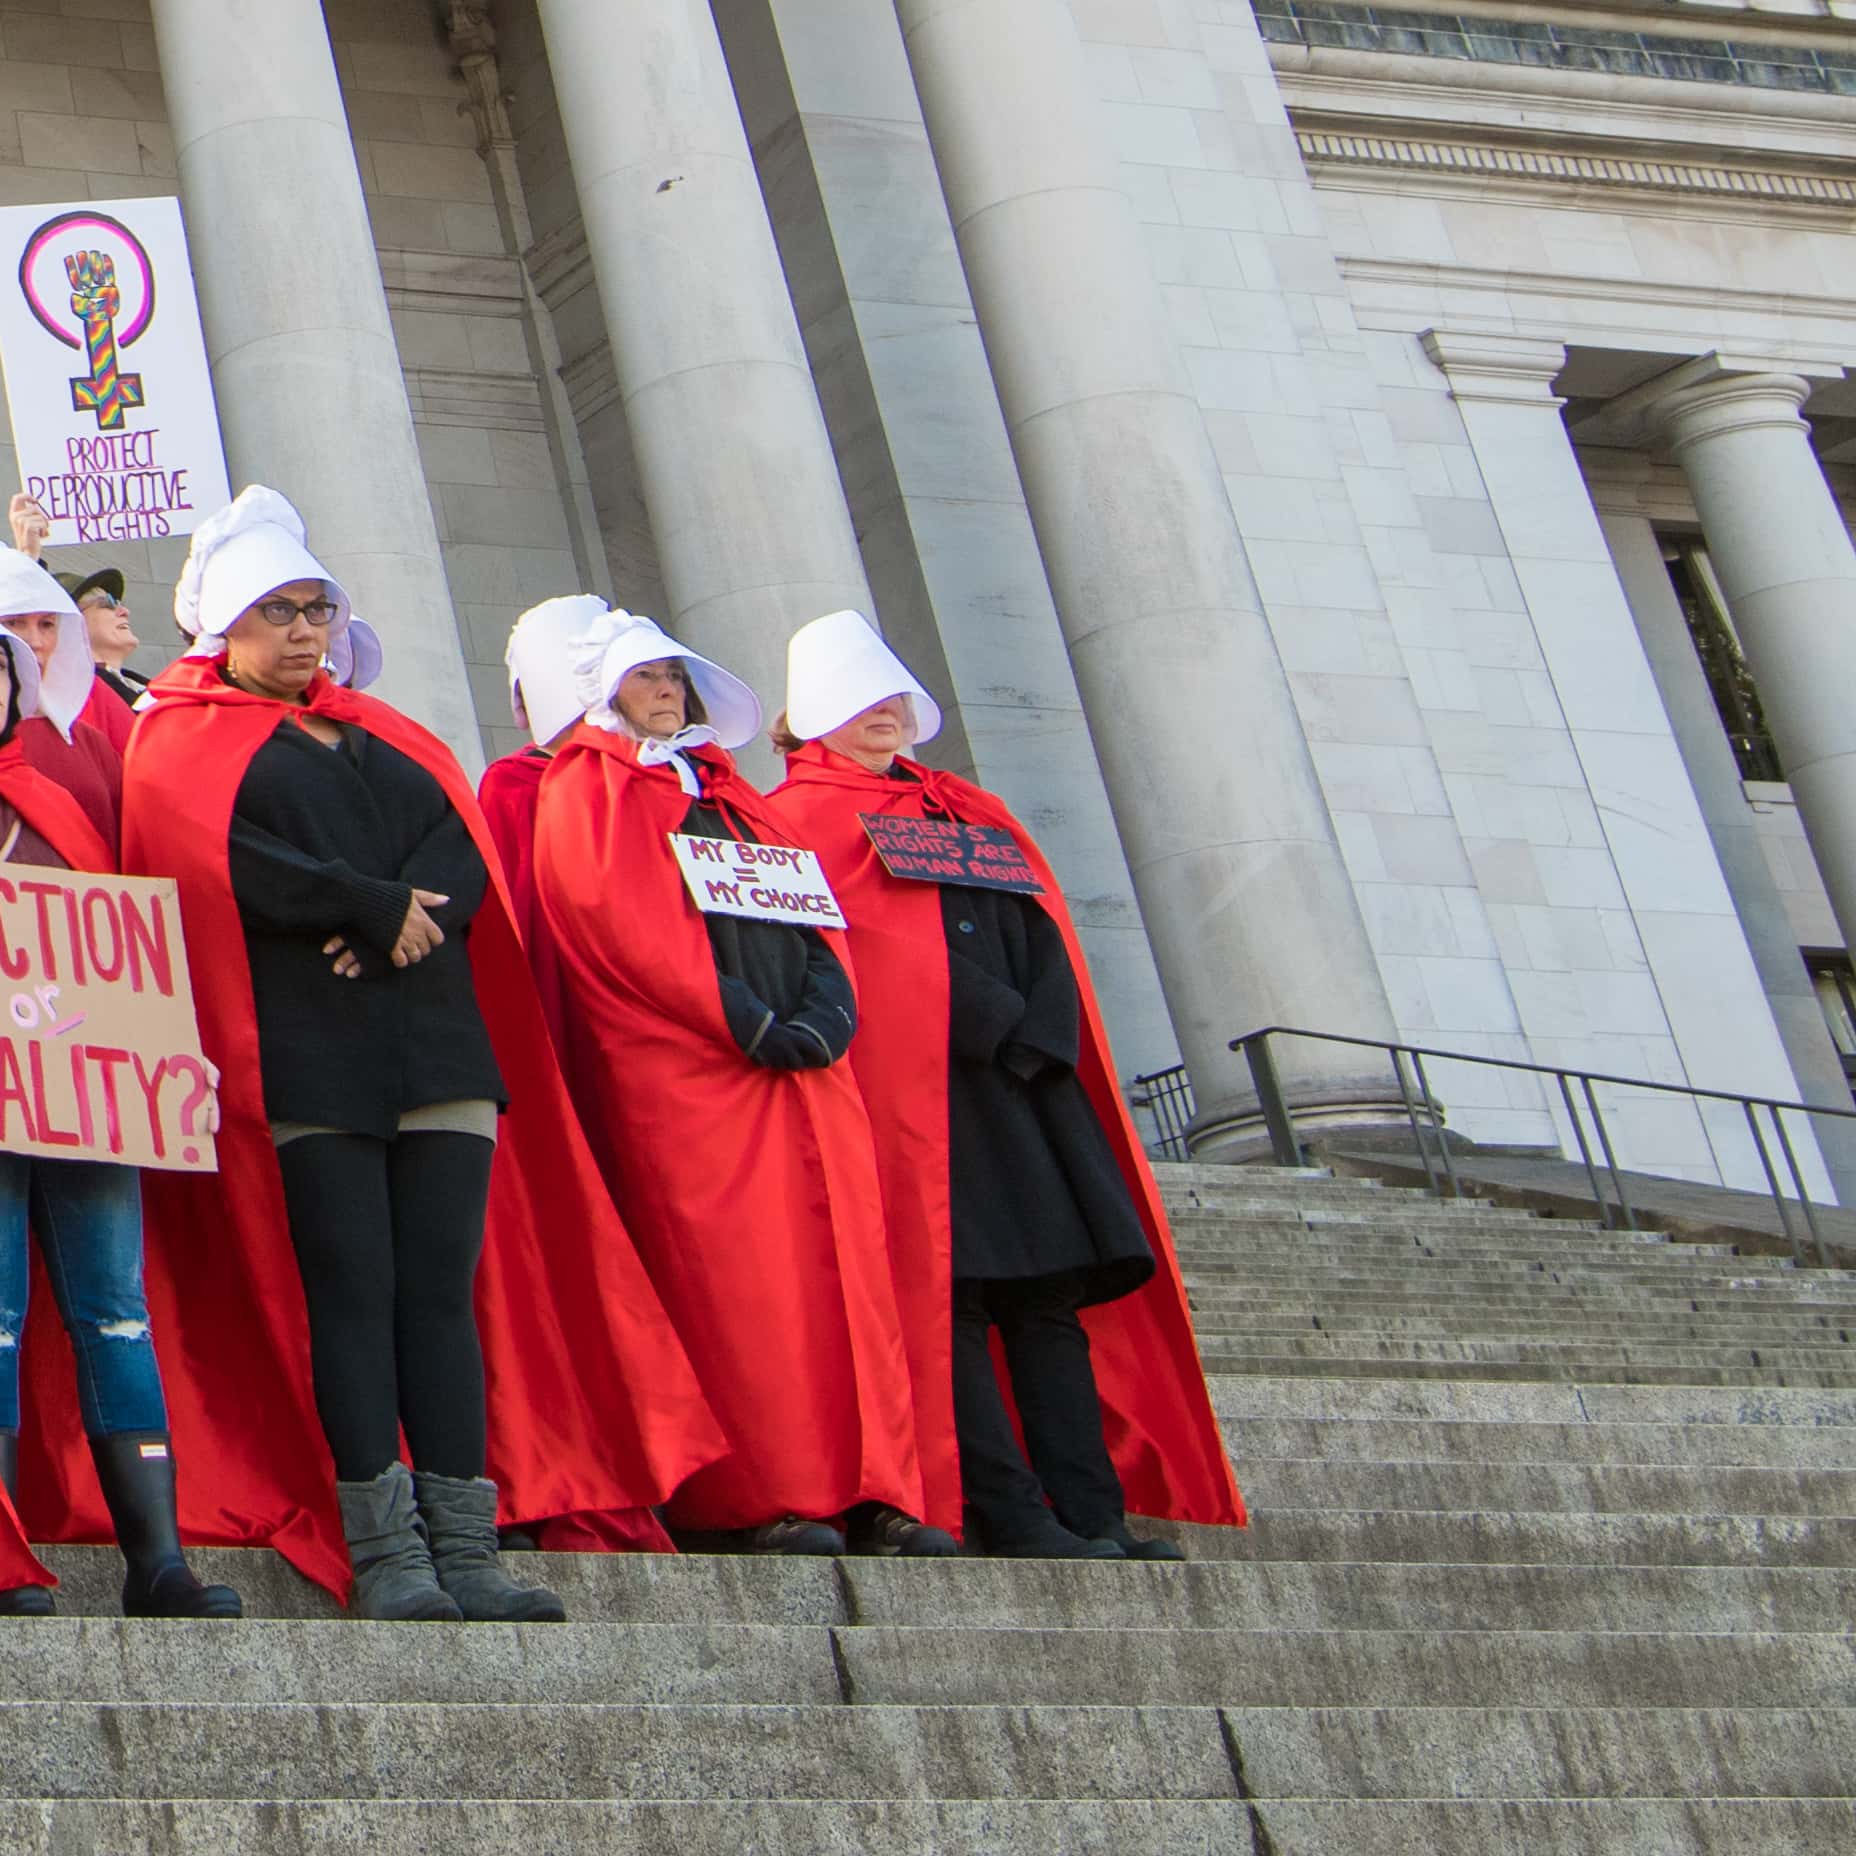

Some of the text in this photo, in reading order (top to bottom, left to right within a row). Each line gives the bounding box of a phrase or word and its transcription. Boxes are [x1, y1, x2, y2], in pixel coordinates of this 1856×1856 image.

[66, 429, 160, 474] PROTECT
[28, 469, 193, 520] REPRODUCTIVE
[76, 511, 171, 544] RIGHTS
[688, 838, 803, 875] MY BODY
[873, 833, 1025, 865] RIGHTS ARE
[883, 853, 966, 877] HUMAN
[704, 880, 841, 918] MY CHOICE
[9, 984, 62, 1030] or
